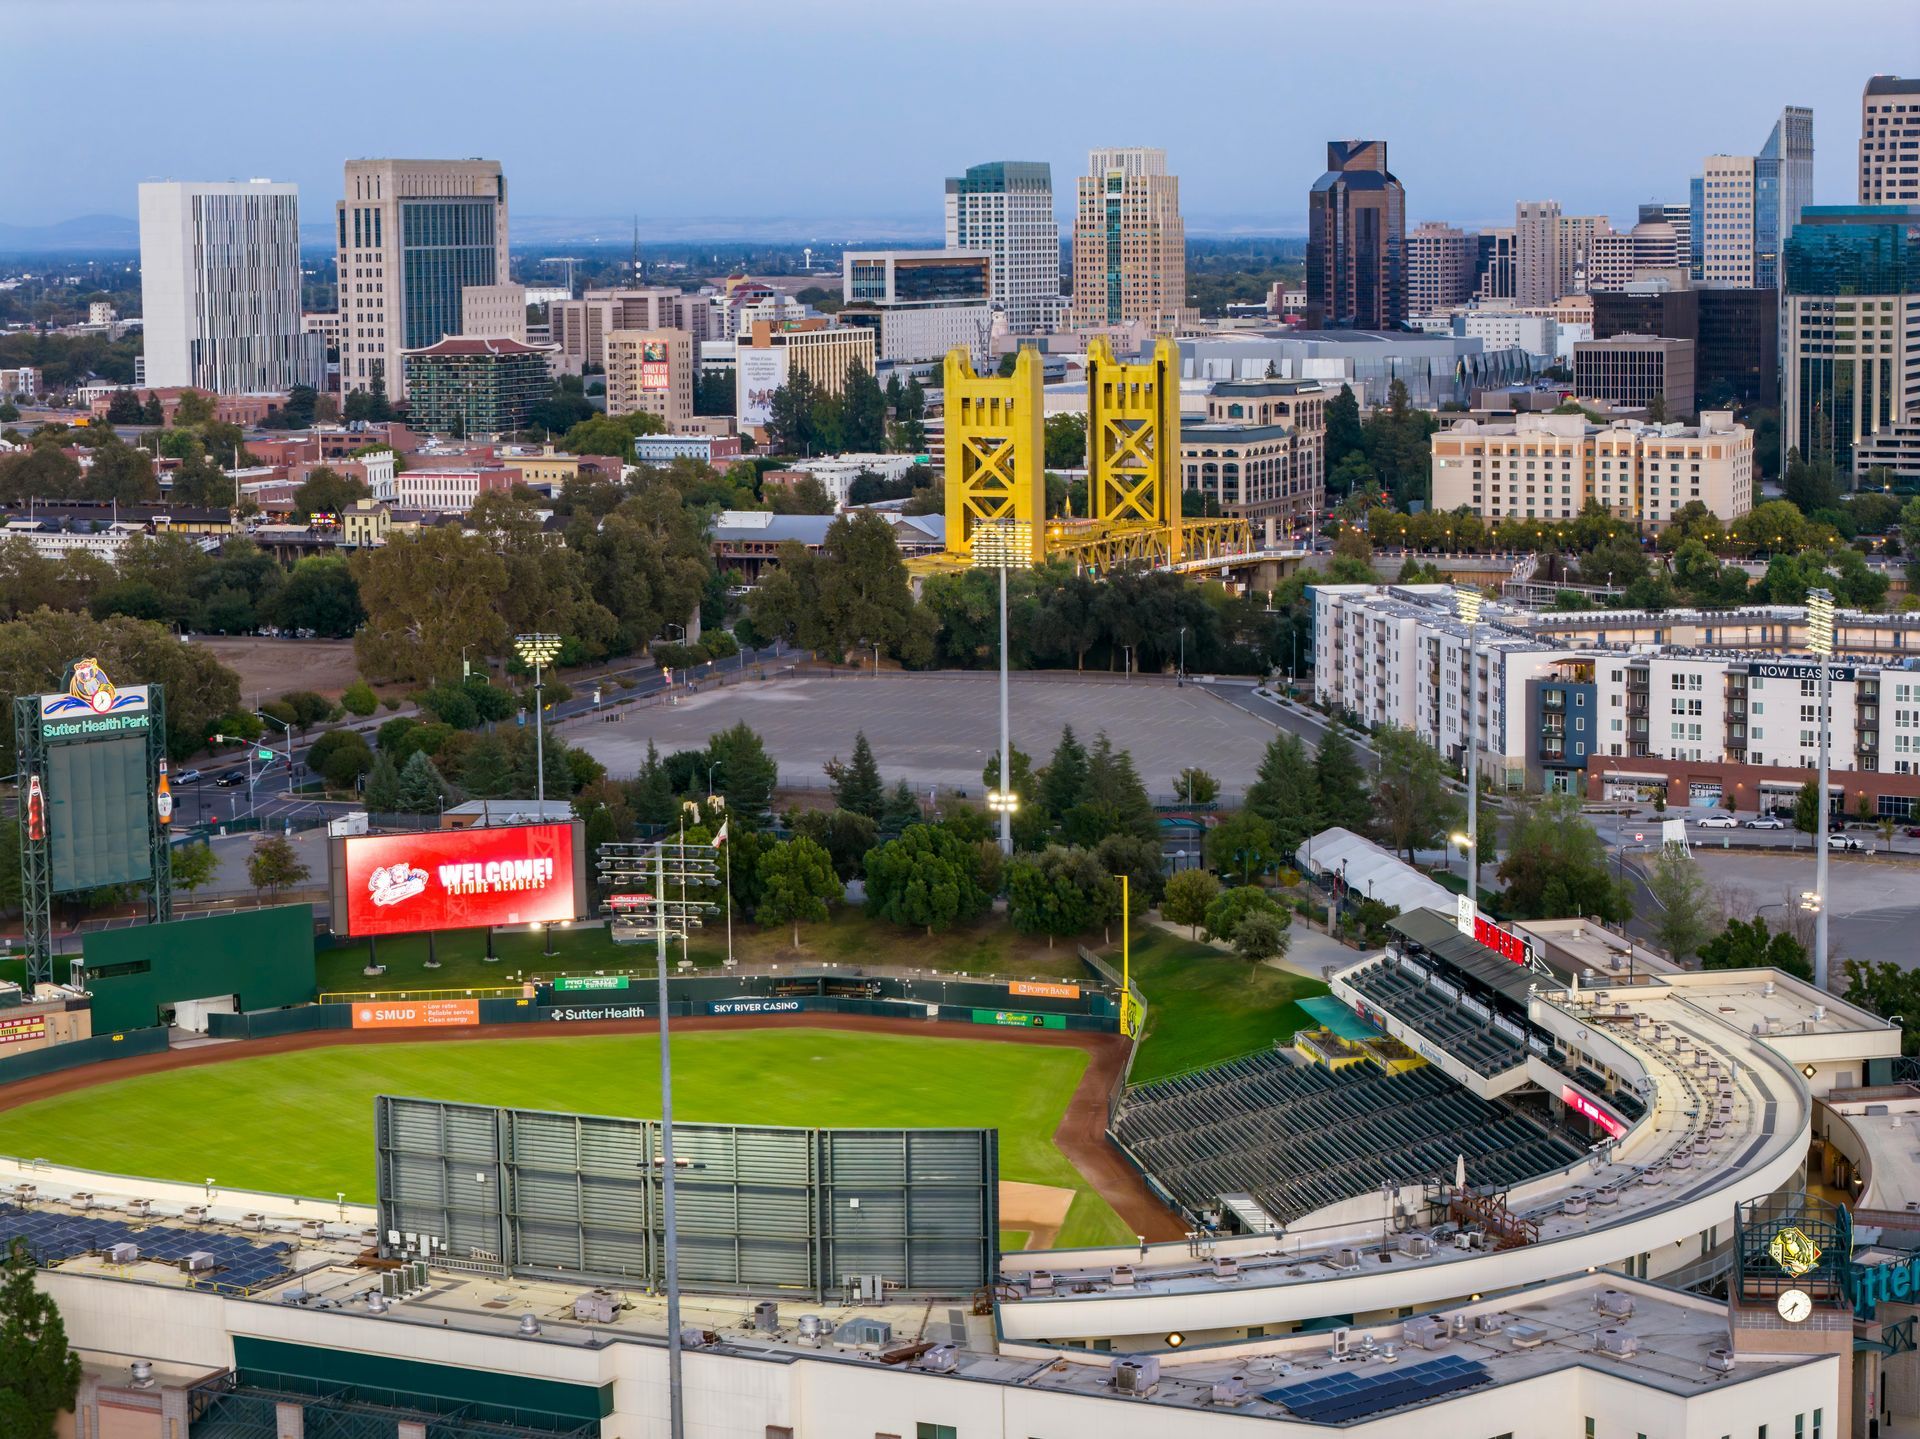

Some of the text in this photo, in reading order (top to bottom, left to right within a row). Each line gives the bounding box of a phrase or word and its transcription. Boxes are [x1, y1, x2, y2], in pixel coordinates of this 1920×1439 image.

[643, 364, 668, 374] ONLY BY
[643, 374, 668, 386] TRAIN
[1759, 666, 1845, 679] NOW LEASNG
[43, 714, 150, 737] Sutter Health Park
[438, 858, 553, 887] WELCOME!
[447, 877, 546, 895] FUTURE MEMBERS
[1027, 985, 1070, 995] POPPY BANK
[565, 1007, 644, 1020] Sutter Health
[714, 1002, 799, 1013] SKY RIVER CASINO
[375, 1009, 416, 1021] SMUD
